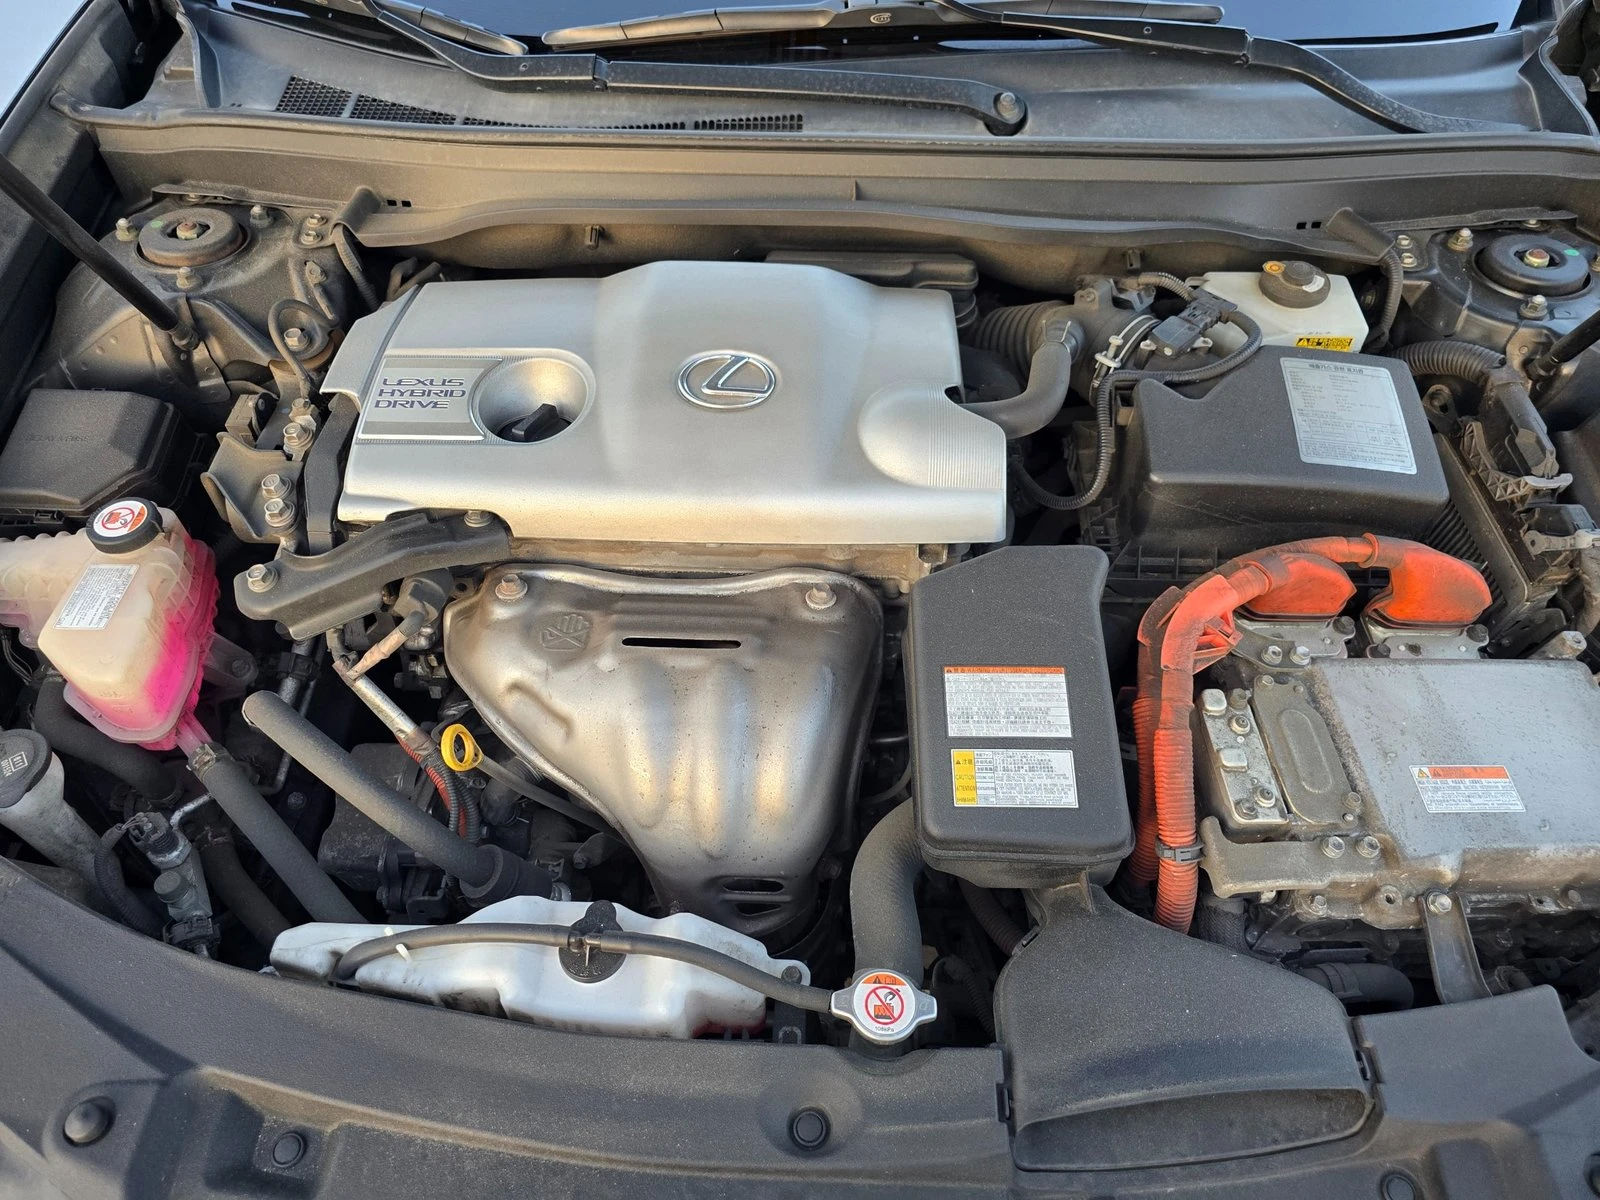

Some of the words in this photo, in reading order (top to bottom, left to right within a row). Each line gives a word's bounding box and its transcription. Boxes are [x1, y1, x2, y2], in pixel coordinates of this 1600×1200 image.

[382, 378, 465, 387] LEXUS
[378, 389, 467, 398] HYBRID
[374, 400, 450, 409] DRIVE
